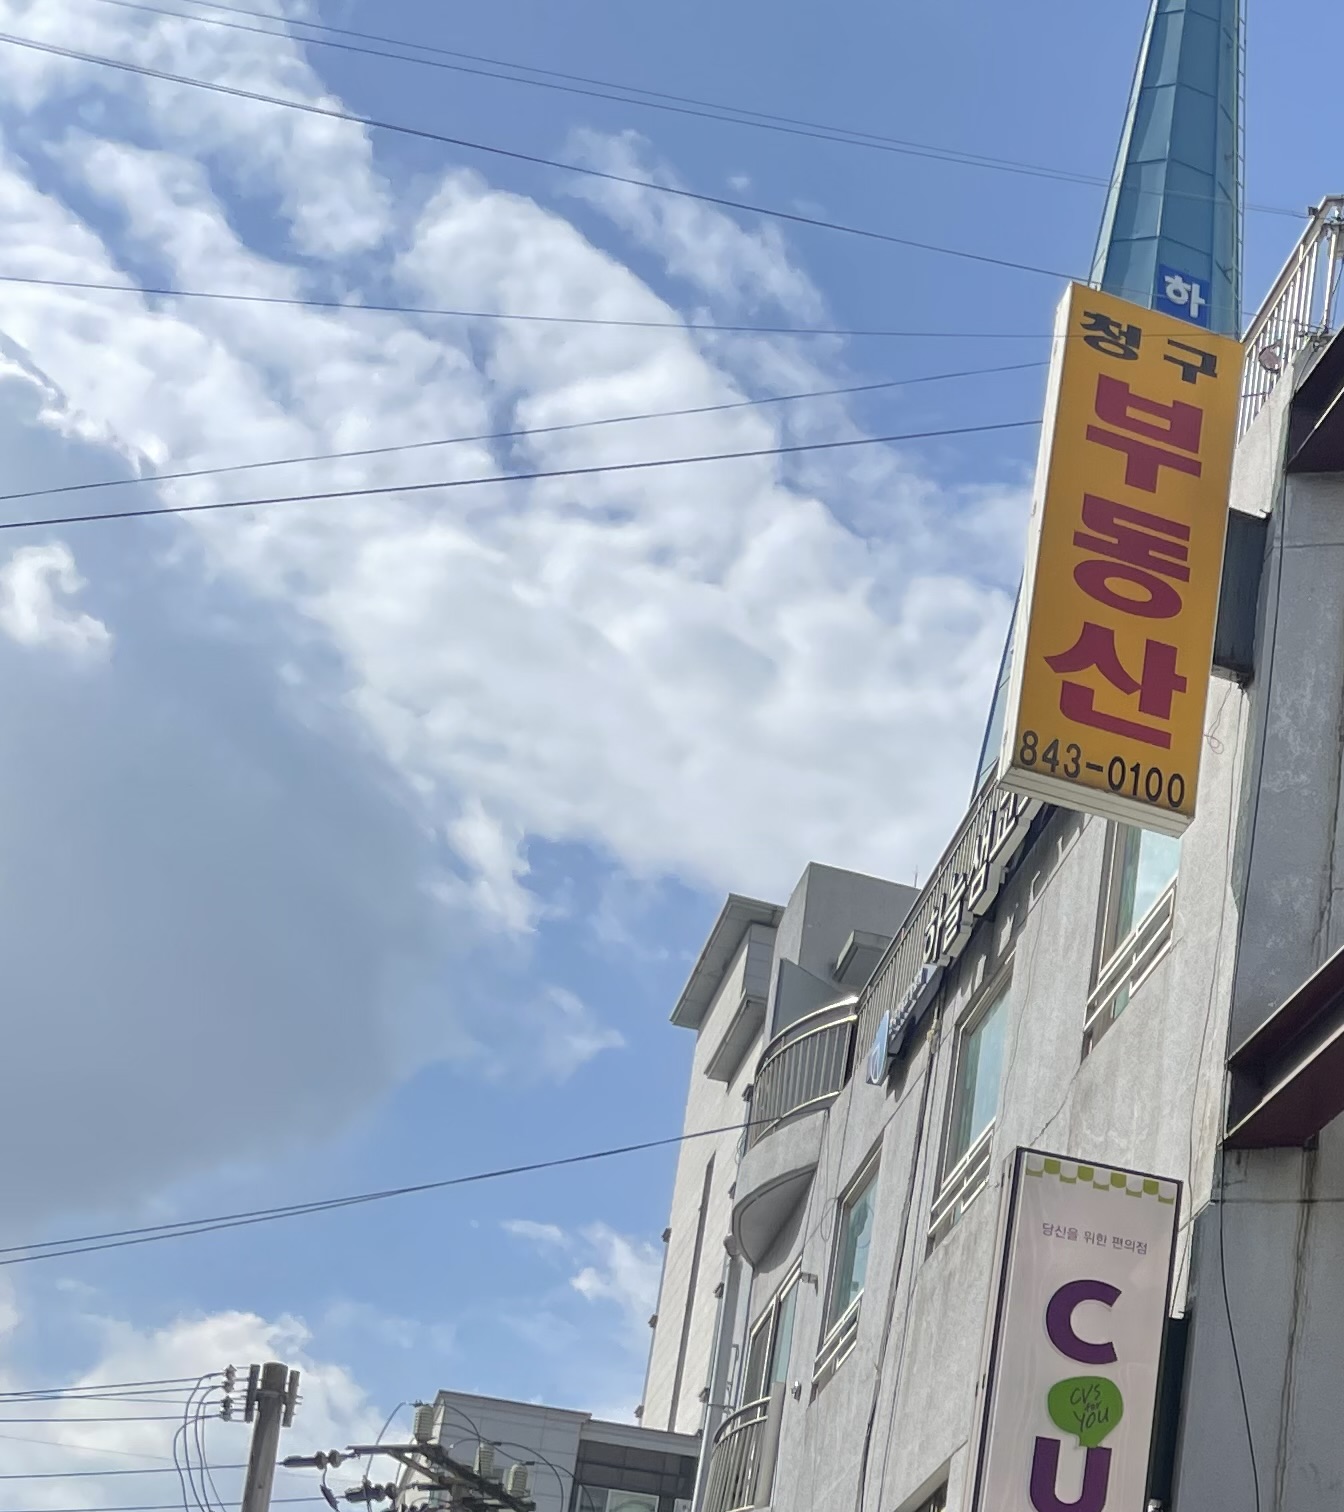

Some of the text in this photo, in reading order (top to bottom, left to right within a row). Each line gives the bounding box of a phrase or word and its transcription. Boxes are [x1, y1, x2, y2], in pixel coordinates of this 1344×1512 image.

[1079, 311, 1218, 384] 청구
[1043, 373, 1203, 750] 부동산
[1018, 729, 1186, 809] 843-0100
[922, 792, 1031, 966] 하늘샘교
[1041, 1221, 1149, 1256] 당신을 위한 편의점
[1069, 1383, 1102, 1407] CVS
[1072, 1407, 1109, 1433] YOU
